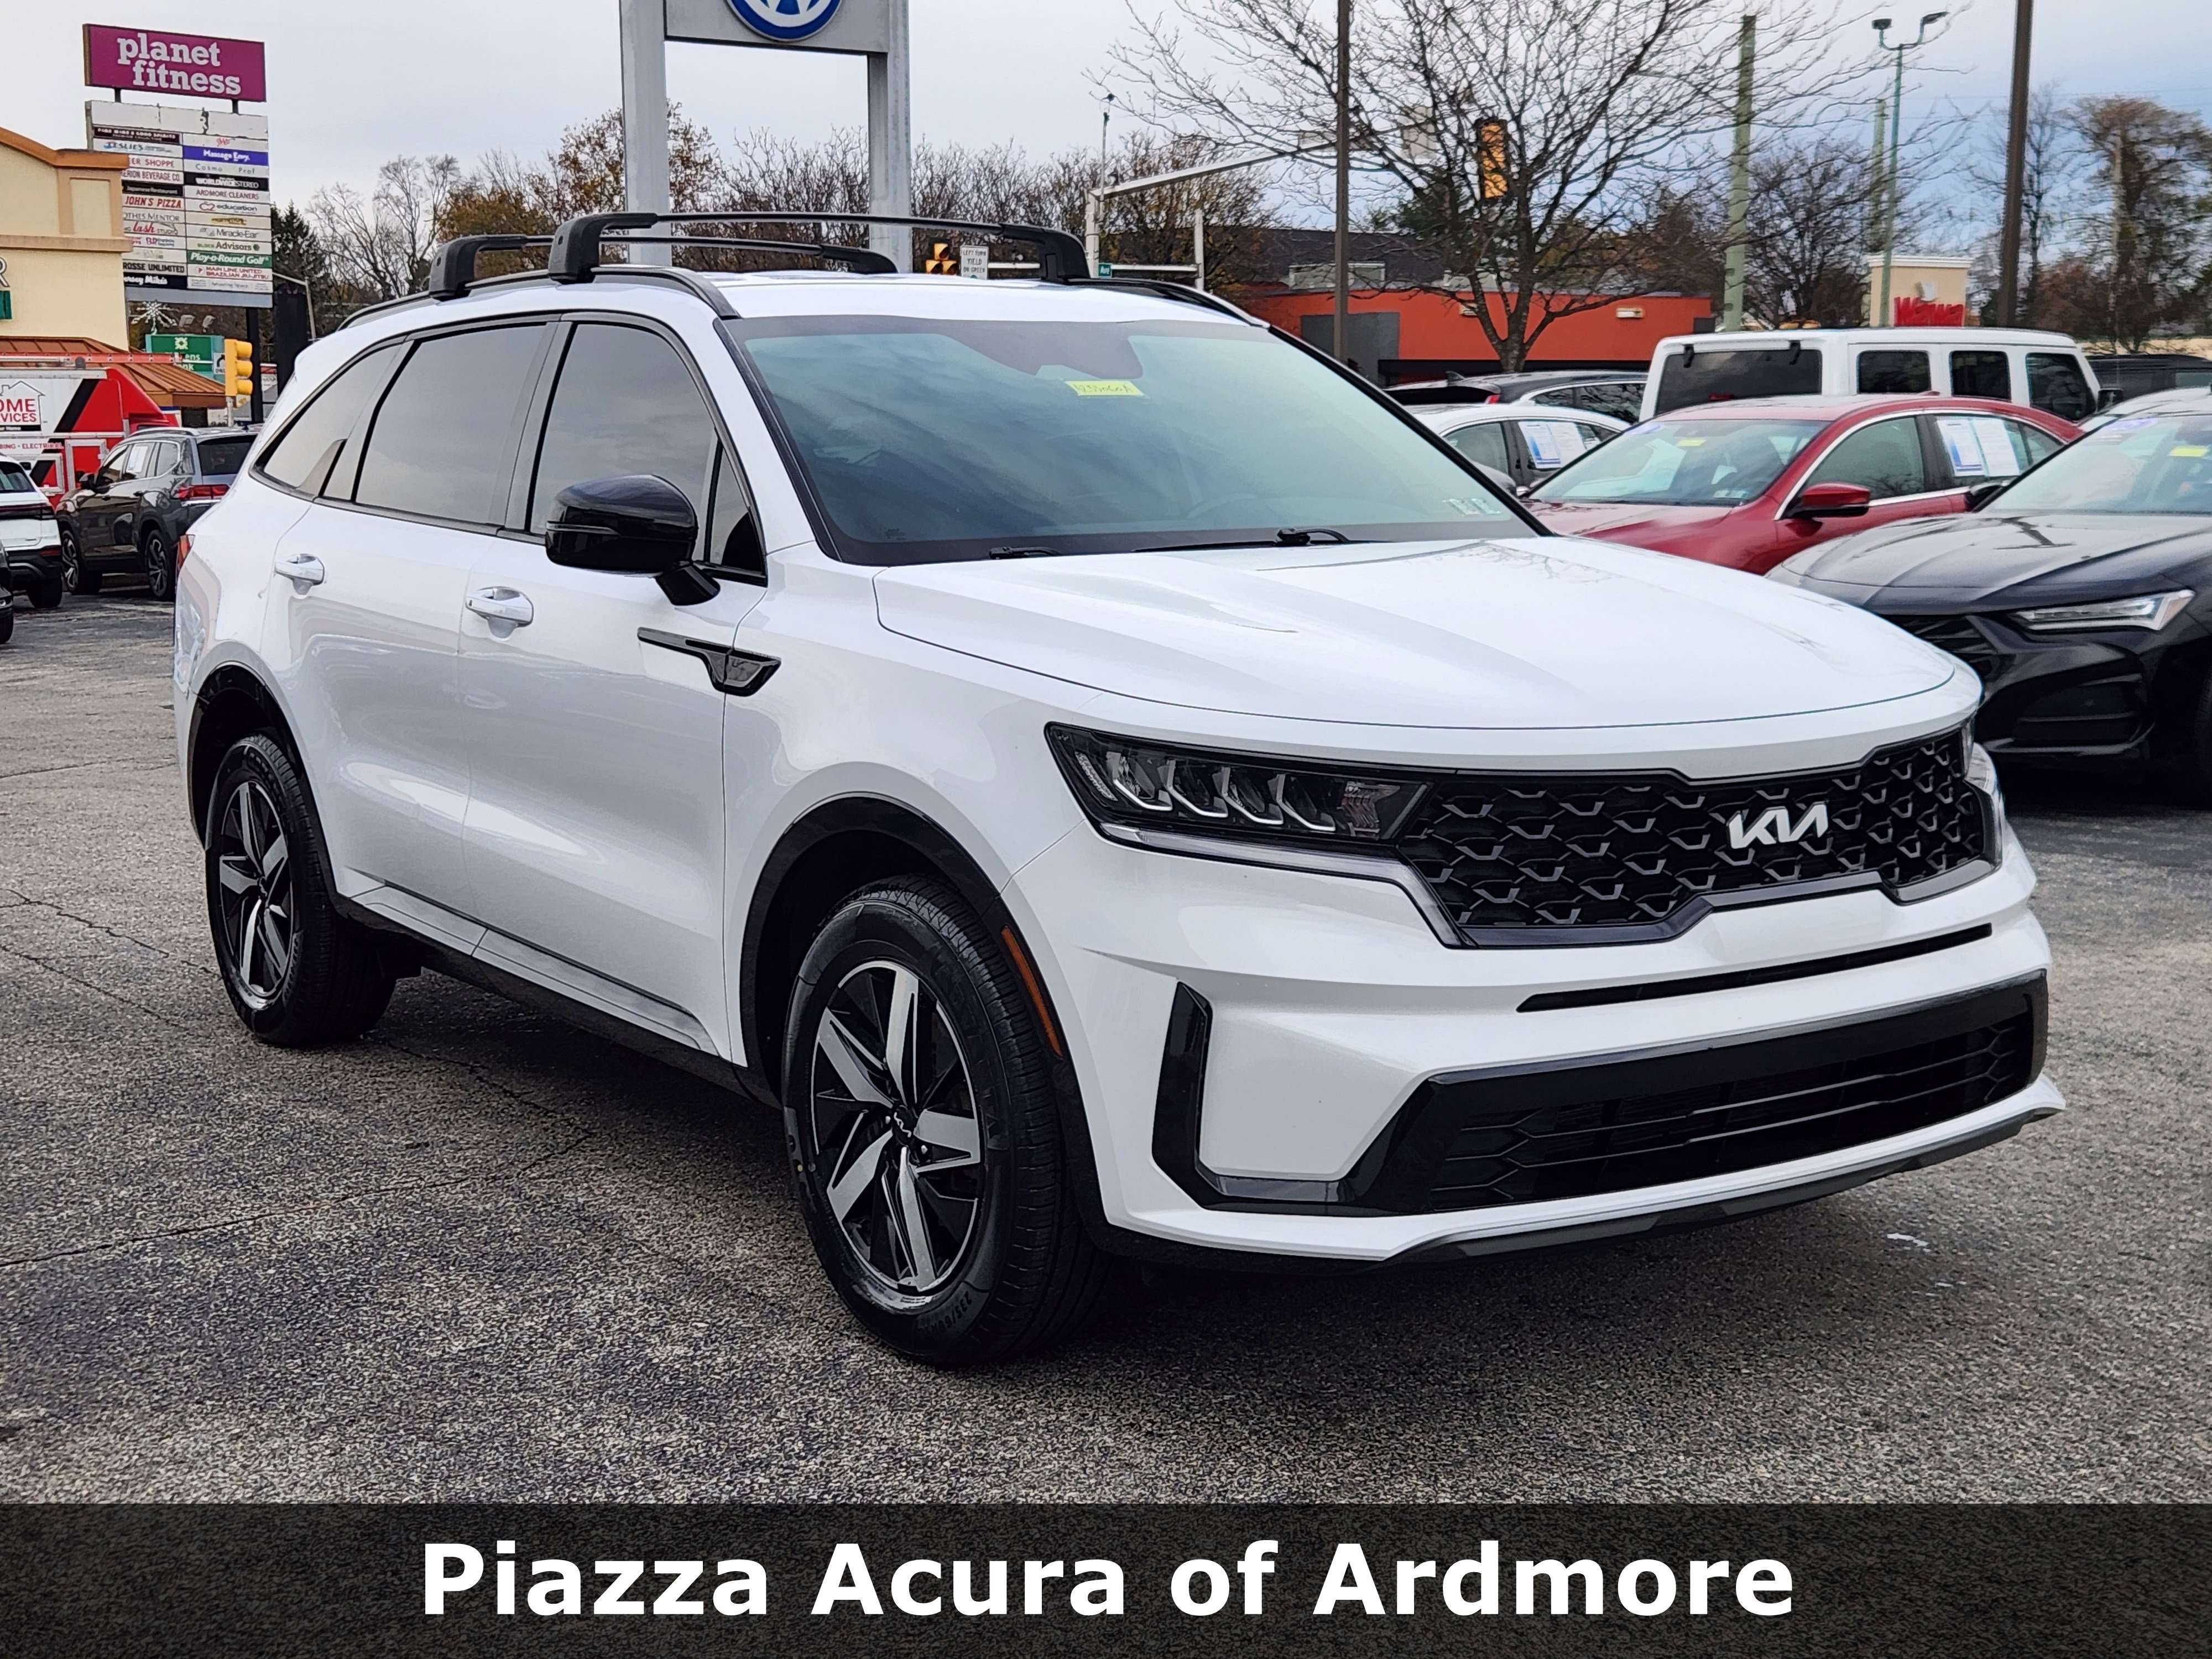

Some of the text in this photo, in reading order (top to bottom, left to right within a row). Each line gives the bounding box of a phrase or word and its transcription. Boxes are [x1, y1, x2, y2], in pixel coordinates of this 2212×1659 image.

[117, 33, 221, 66] planet
[133, 60, 241, 95] fitness
[145, 159, 175, 168] SHOPPE
[142, 171, 170, 181] BEVERAGE
[196, 190, 259, 200] ARDMORE CLEANERS
[126, 196, 181, 208] JOHN'S PIZZA
[216, 228, 259, 238] Miracle-Ear
[216, 241, 252, 251] Advisors
[148, 264, 185, 273] UNLIMITED
[1893, 296, 1964, 327] Wawa
[1726, 802, 1829, 849] KIA
